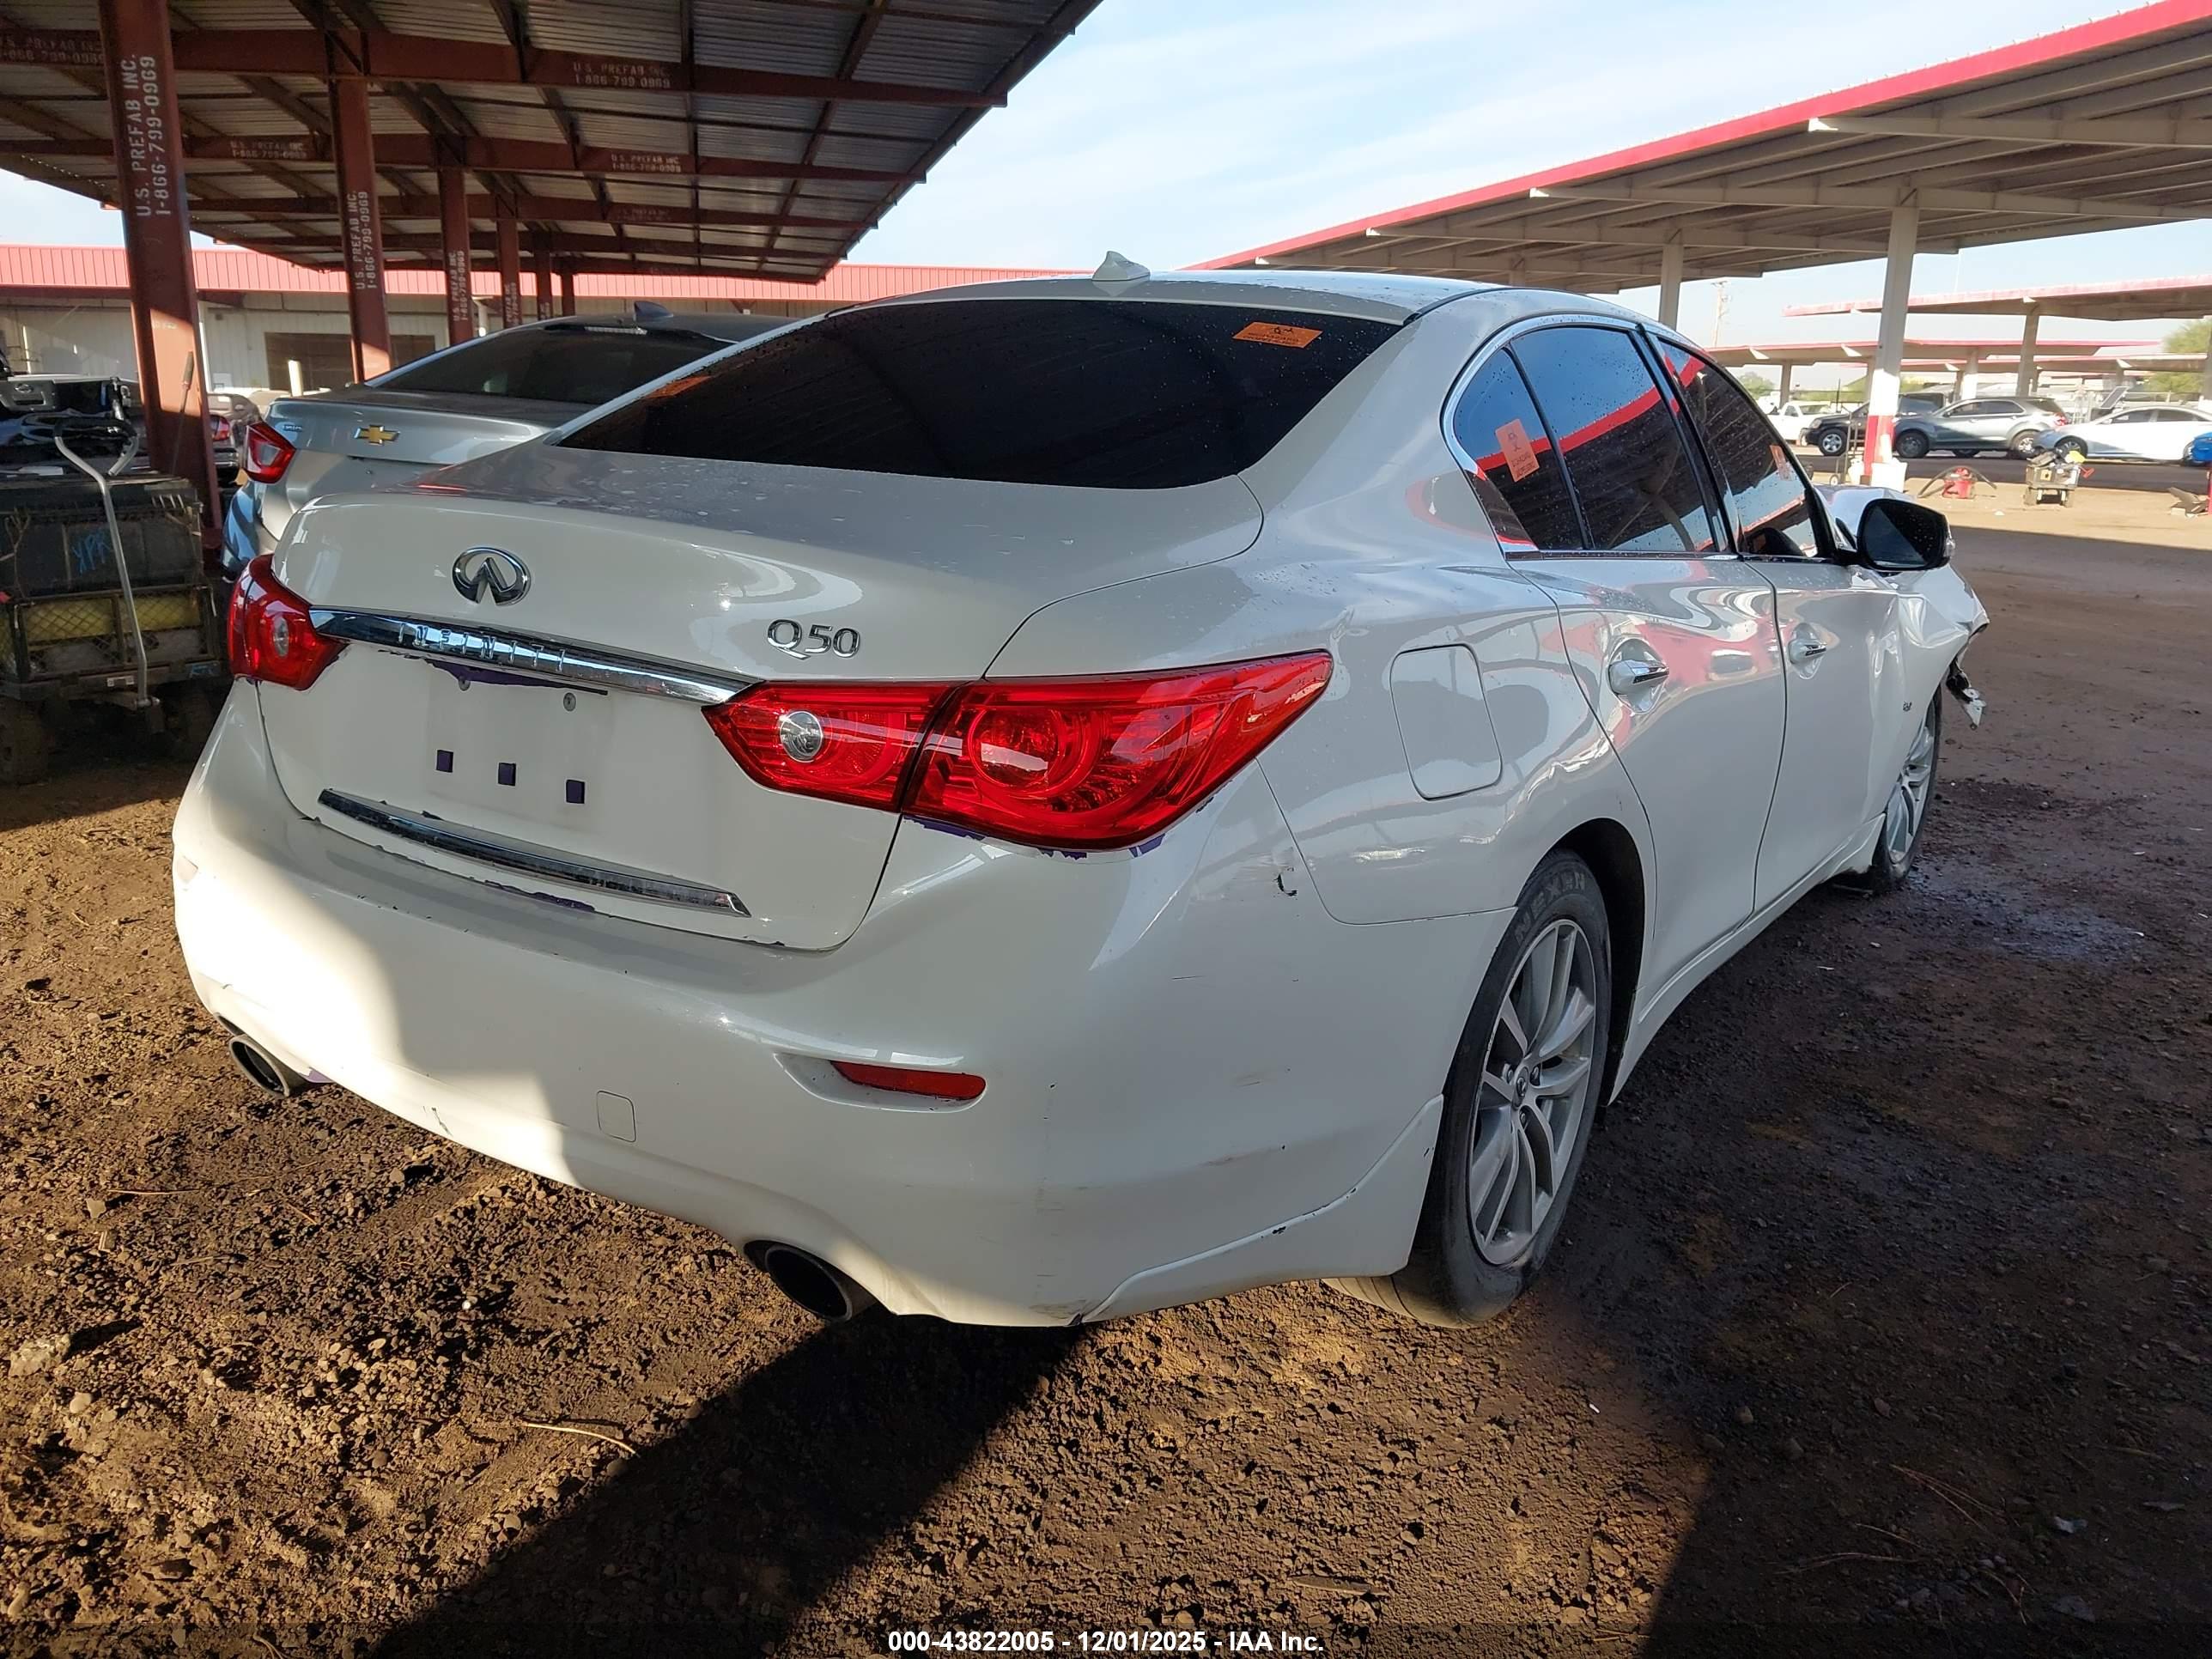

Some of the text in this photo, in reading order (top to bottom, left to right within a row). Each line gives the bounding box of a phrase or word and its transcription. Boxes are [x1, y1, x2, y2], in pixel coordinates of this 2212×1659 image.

[120, 54, 152, 216] U.S. PREFAB INC.
[139, 56, 172, 216] 1-866-799-0969
[349, 218, 363, 262] PREFAB
[357, 191, 378, 289] 1-866-799-0969
[398, 622, 567, 673] INFINITI
[767, 619, 861, 660] Q50
